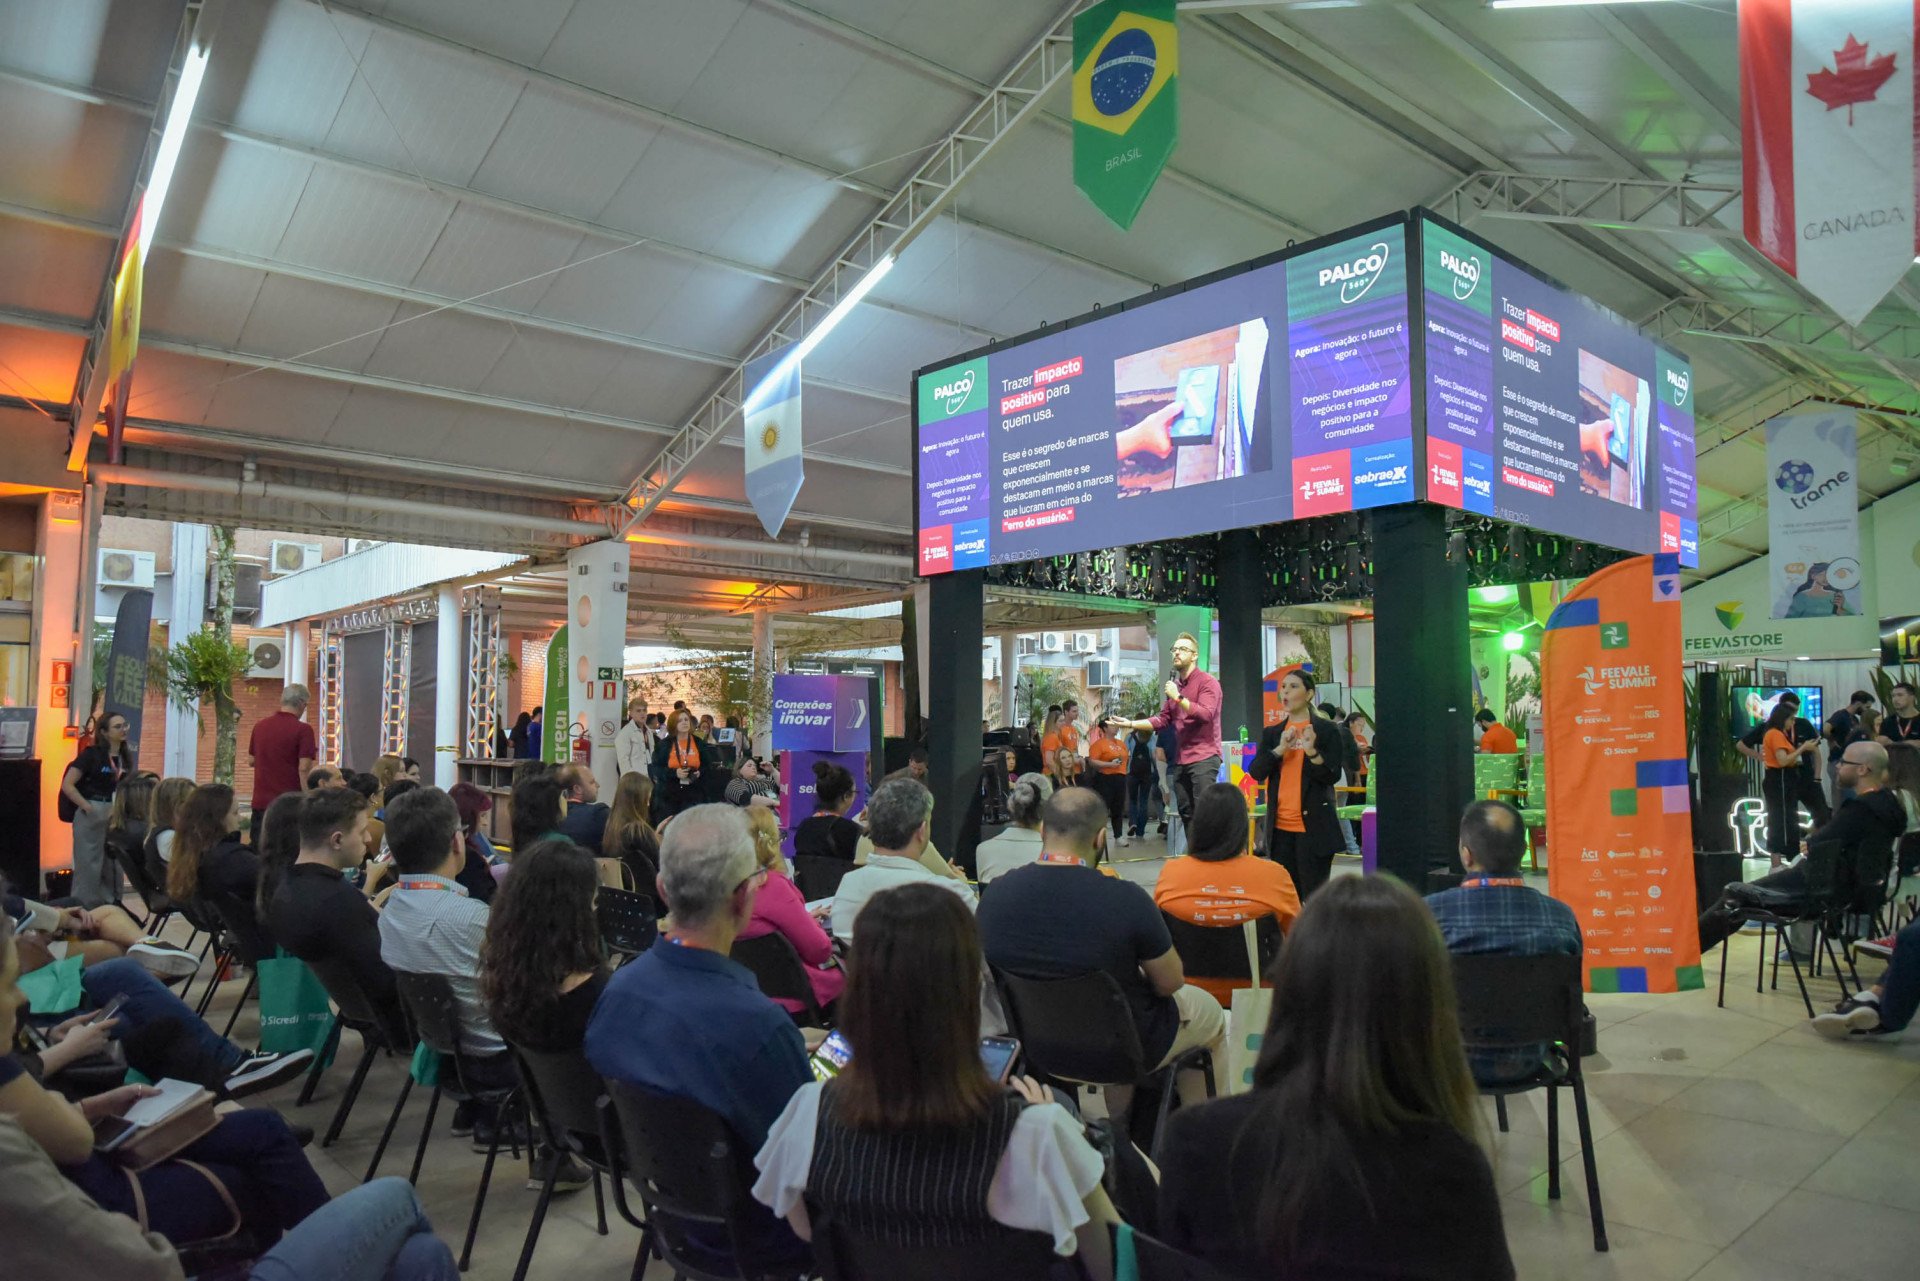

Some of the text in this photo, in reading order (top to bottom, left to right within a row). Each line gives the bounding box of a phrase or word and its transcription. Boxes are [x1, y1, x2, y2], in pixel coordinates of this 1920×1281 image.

[1105, 148, 1142, 171] BRASIL
[1803, 207, 1905, 240] CANADA
[1319, 254, 1382, 286] PALCO
[1440, 250, 1477, 282] PALCO
[1502, 296, 1559, 338] Trazer impacto
[1295, 344, 1321, 358] Agora:
[1361, 333, 1367, 341] o
[1368, 326, 1395, 339] futuro
[1396, 322, 1402, 332] é
[1502, 323, 1552, 356] positivo para
[1334, 348, 1358, 361] agora
[1502, 346, 1541, 373] quem usa.
[1001, 360, 1080, 392] Trazer impacto
[1667, 369, 1687, 391] PALCO
[934, 379, 970, 400] PALCO
[1001, 384, 1070, 413] positivo para
[1302, 378, 1397, 406] Depois: Diversidade nos
[1312, 401, 1346, 416] negócios
[1354, 394, 1388, 407] impacto
[1502, 385, 1576, 424] Esse é o segredo de marcas
[1503, 405, 1539, 427] que crescem
[1002, 408, 1054, 432] quem usa.
[1320, 415, 1351, 428] positivo
[1353, 410, 1371, 422] para
[1325, 422, 1375, 439] comunidade
[1002, 430, 1109, 462] Esse é o segredo de marcas
[1503, 422, 1552, 448] exponencialmente
[1557, 442, 1564, 451] se
[1503, 437, 1531, 456] destacam
[1531, 449, 1540, 459] em
[1540, 451, 1554, 464] meio
[1559, 457, 1579, 472] marcas
[1003, 458, 1051, 477] que crescem
[1003, 464, 1090, 490] exponencialmente e se
[1503, 455, 1565, 483] que lucram em cima do
[943, 474, 971, 485] Diversidade
[956, 483, 976, 493] impacto
[1003, 474, 1114, 504] destacam em meio a marcas
[1519, 475, 1527, 487] do
[1790, 469, 1850, 510] trame
[939, 505, 968, 516] comunidade
[1003, 492, 1092, 519] que lucram em cima do
[1025, 517, 1035, 528] do
[1685, 633, 1783, 650] FEEVASTORE
[1600, 665, 1650, 679] FEEVALE
[1609, 675, 1657, 689] SUMMIT
[774, 699, 832, 710] Conexões
[1645, 709, 1660, 719] RBS
[779, 712, 832, 726] inovar
[267, 1014, 299, 1025] Sicredi
